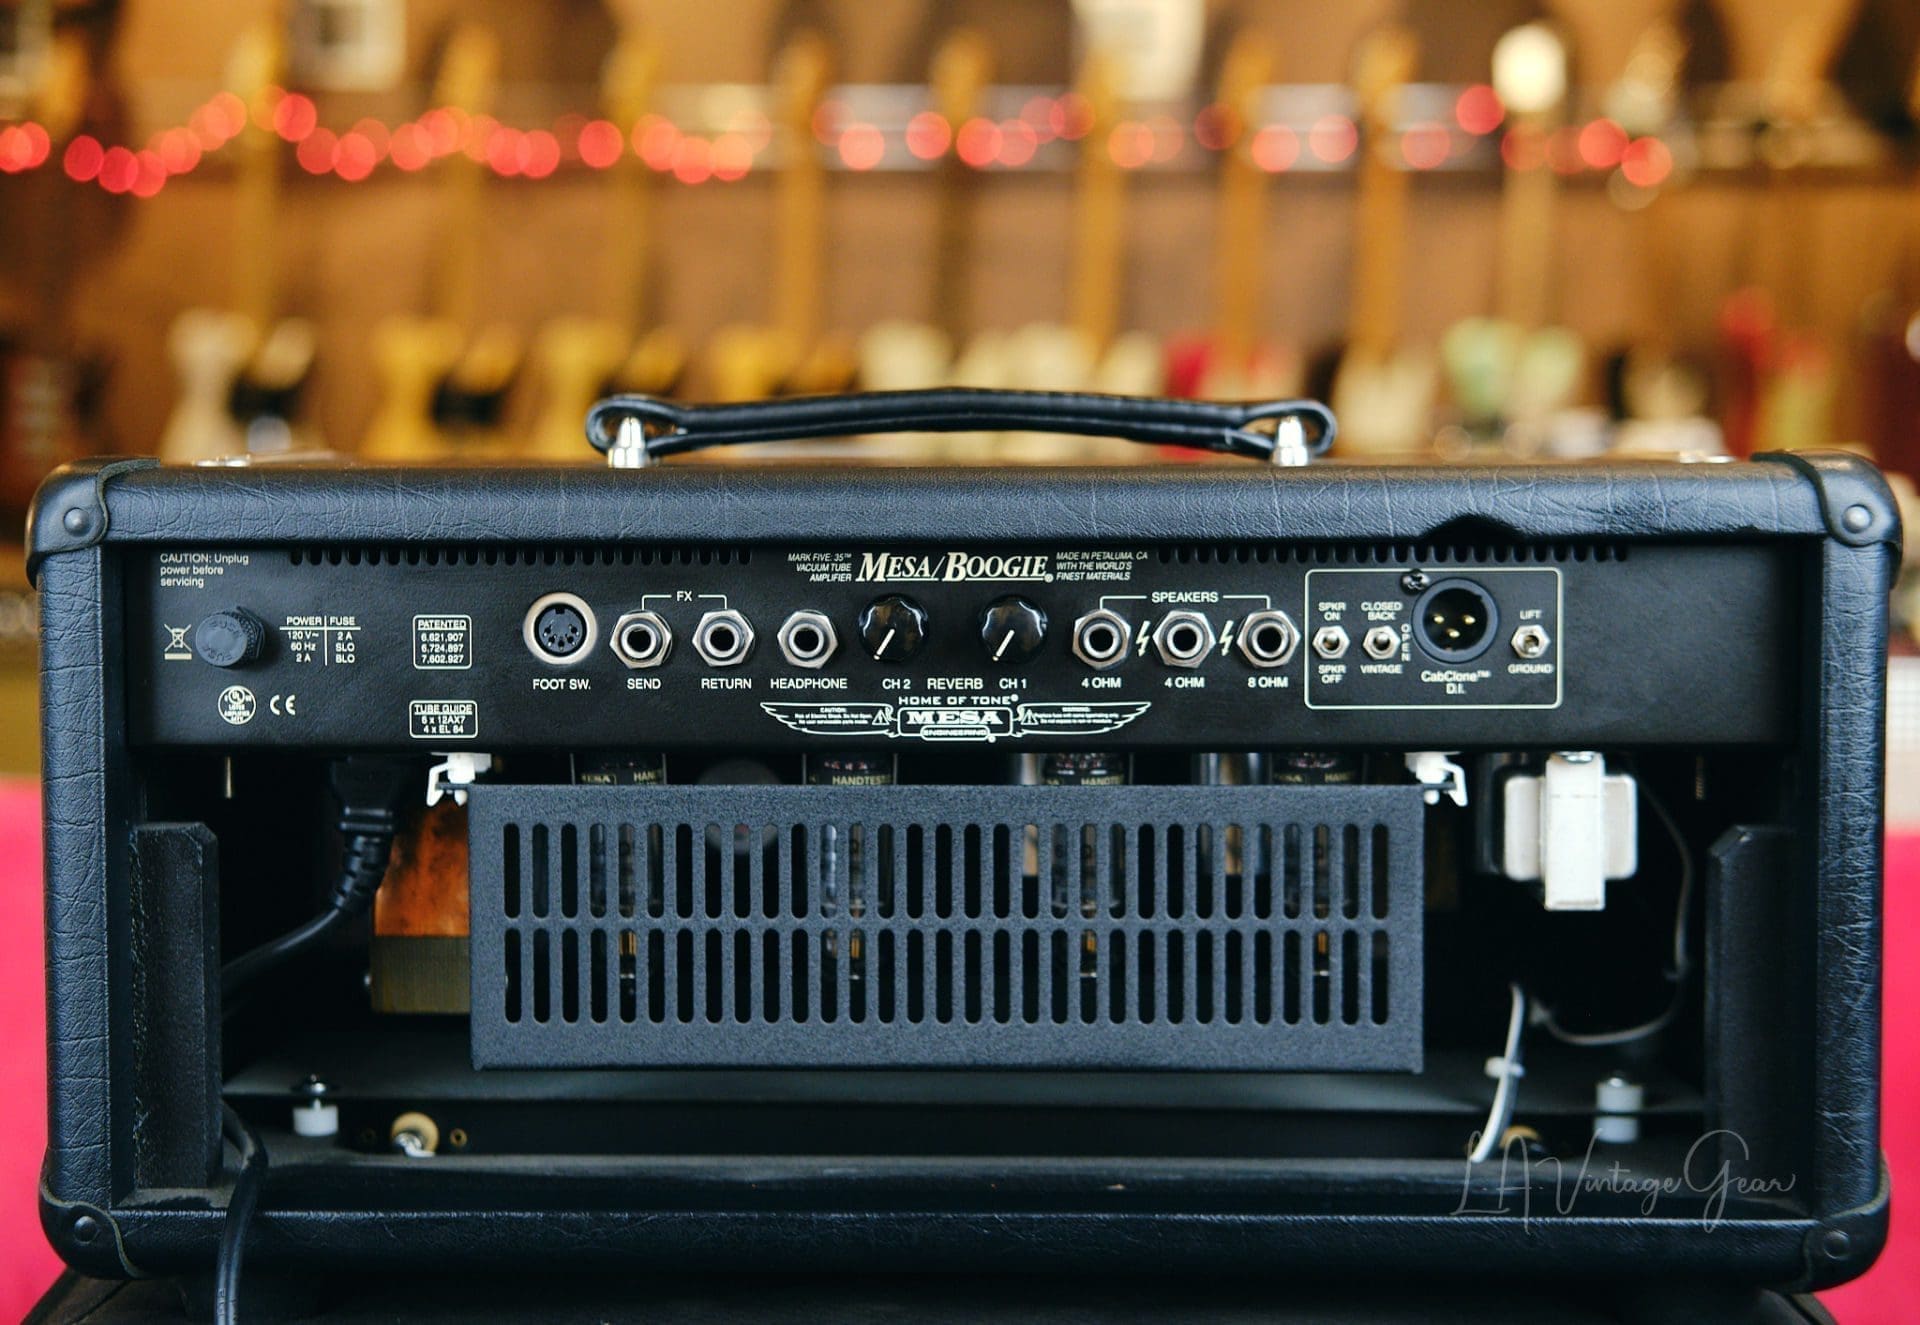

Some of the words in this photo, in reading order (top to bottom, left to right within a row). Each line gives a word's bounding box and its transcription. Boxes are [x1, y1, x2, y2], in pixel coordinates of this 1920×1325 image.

[160, 553, 212, 563] CAUTION:
[214, 553, 249, 565] Unplug
[788, 553, 811, 562] MARK
[1056, 552, 1080, 560] MADE
[1081, 552, 1089, 560] IN
[1136, 552, 1148, 560] CA
[160, 566, 191, 576] power
[193, 565, 224, 575] before
[796, 563, 829, 572] VACUUM
[830, 563, 852, 572] TUBE
[1056, 562, 1075, 571] WITH
[1076, 562, 1094, 571] THE
[1095, 562, 1132, 571] WORLD'S
[809, 573, 852, 582] AMPLIFIER
[1056, 572, 1087, 581] FINEST
[1088, 572, 1131, 581] MATERIALS
[160, 577, 205, 588] servicing
[676, 591, 693, 602] FX
[1151, 592, 1219, 603] SPEAKERS
[1318, 602, 1347, 612] SPKR
[1361, 602, 1402, 612] CLOSED
[1324, 611, 1341, 621] ON
[1368, 611, 1396, 621] BACK
[1520, 610, 1542, 620] LIFT
[286, 617, 323, 626] POWER
[330, 617, 356, 626] FUSE
[418, 620, 467, 630] PATENTED
[287, 632, 303, 640] 120
[337, 632, 345, 640] 2
[345, 632, 353, 640] A
[291, 643, 302, 651] 60
[303, 643, 317, 651] Hz
[336, 643, 355, 651] SLO
[296, 654, 303, 662] 2
[303, 654, 312, 662] A
[336, 654, 355, 663] BLO
[1318, 665, 1347, 674] SPKR
[1360, 665, 1403, 674] VINTAGE
[1508, 664, 1554, 674] GROUND
[627, 678, 661, 690] SEND
[701, 678, 752, 690] RETURN
[770, 678, 847, 689] HEADPHONE
[1081, 677, 1090, 688] 4
[1092, 677, 1121, 688] OHM
[1164, 677, 1173, 688] 4
[1174, 677, 1205, 688] OHM
[1248, 677, 1256, 688] 8
[1258, 677, 1288, 688] OHM
[1321, 674, 1342, 684] OFF
[532, 679, 567, 690] FOOT
[569, 679, 591, 690] SW.
[882, 679, 902, 690] CH
[903, 679, 911, 690] 2
[927, 679, 983, 690] REVERB
[999, 679, 1019, 690] CH
[1021, 679, 1027, 690] 1
[1446, 683, 1467, 694] D.I.
[269, 694, 296, 715] CE
[898, 696, 941, 705] HOME
[947, 696, 967, 705] OF
[414, 704, 440, 714] TUBE
[442, 704, 473, 714] GUIDE
[421, 716, 428, 724] 6
[438, 716, 466, 724] 12AX7
[906, 711, 1004, 725] MESA
[423, 725, 429, 734] 4
[439, 725, 451, 734] EL
[453, 725, 464, 734] 84
[923, 729, 987, 737] ENGINEERING
